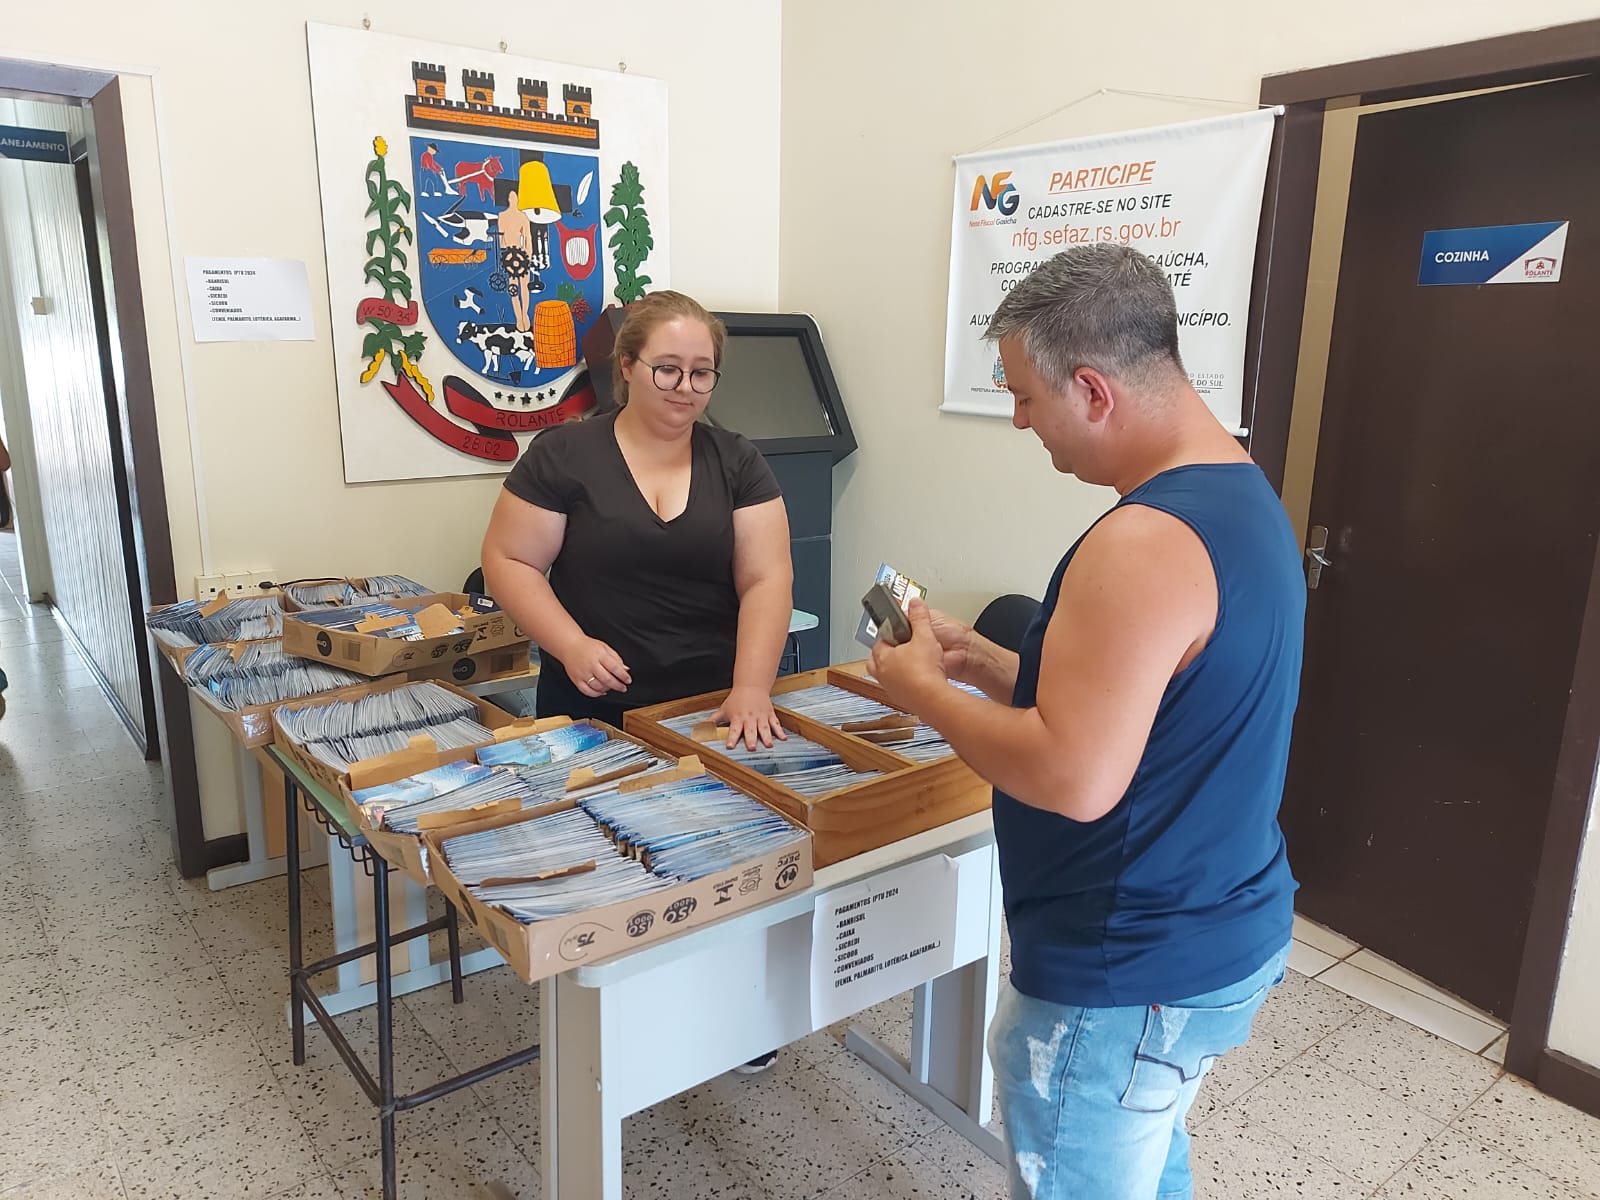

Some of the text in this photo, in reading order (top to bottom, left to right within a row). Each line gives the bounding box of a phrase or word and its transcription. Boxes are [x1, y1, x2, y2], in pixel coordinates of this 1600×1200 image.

[0, 138, 65, 151] ANEJAMENTO
[1049, 160, 1156, 192] PARTICIPE
[1028, 193, 1172, 220] CADASTRE-SE NO SITE
[1012, 216, 1181, 251] nfg.sefaz.rs.gov.br
[1435, 250, 1489, 263] COZINHA
[990, 261, 1041, 274] PROGRA
[1176, 308, 1231, 327] NICÍPIO.
[496, 407, 565, 428] ROLANTE
[835, 887, 899, 915] PAGAMENTOS IPTU 2024
[836, 953, 874, 973] CONVENIADOS
